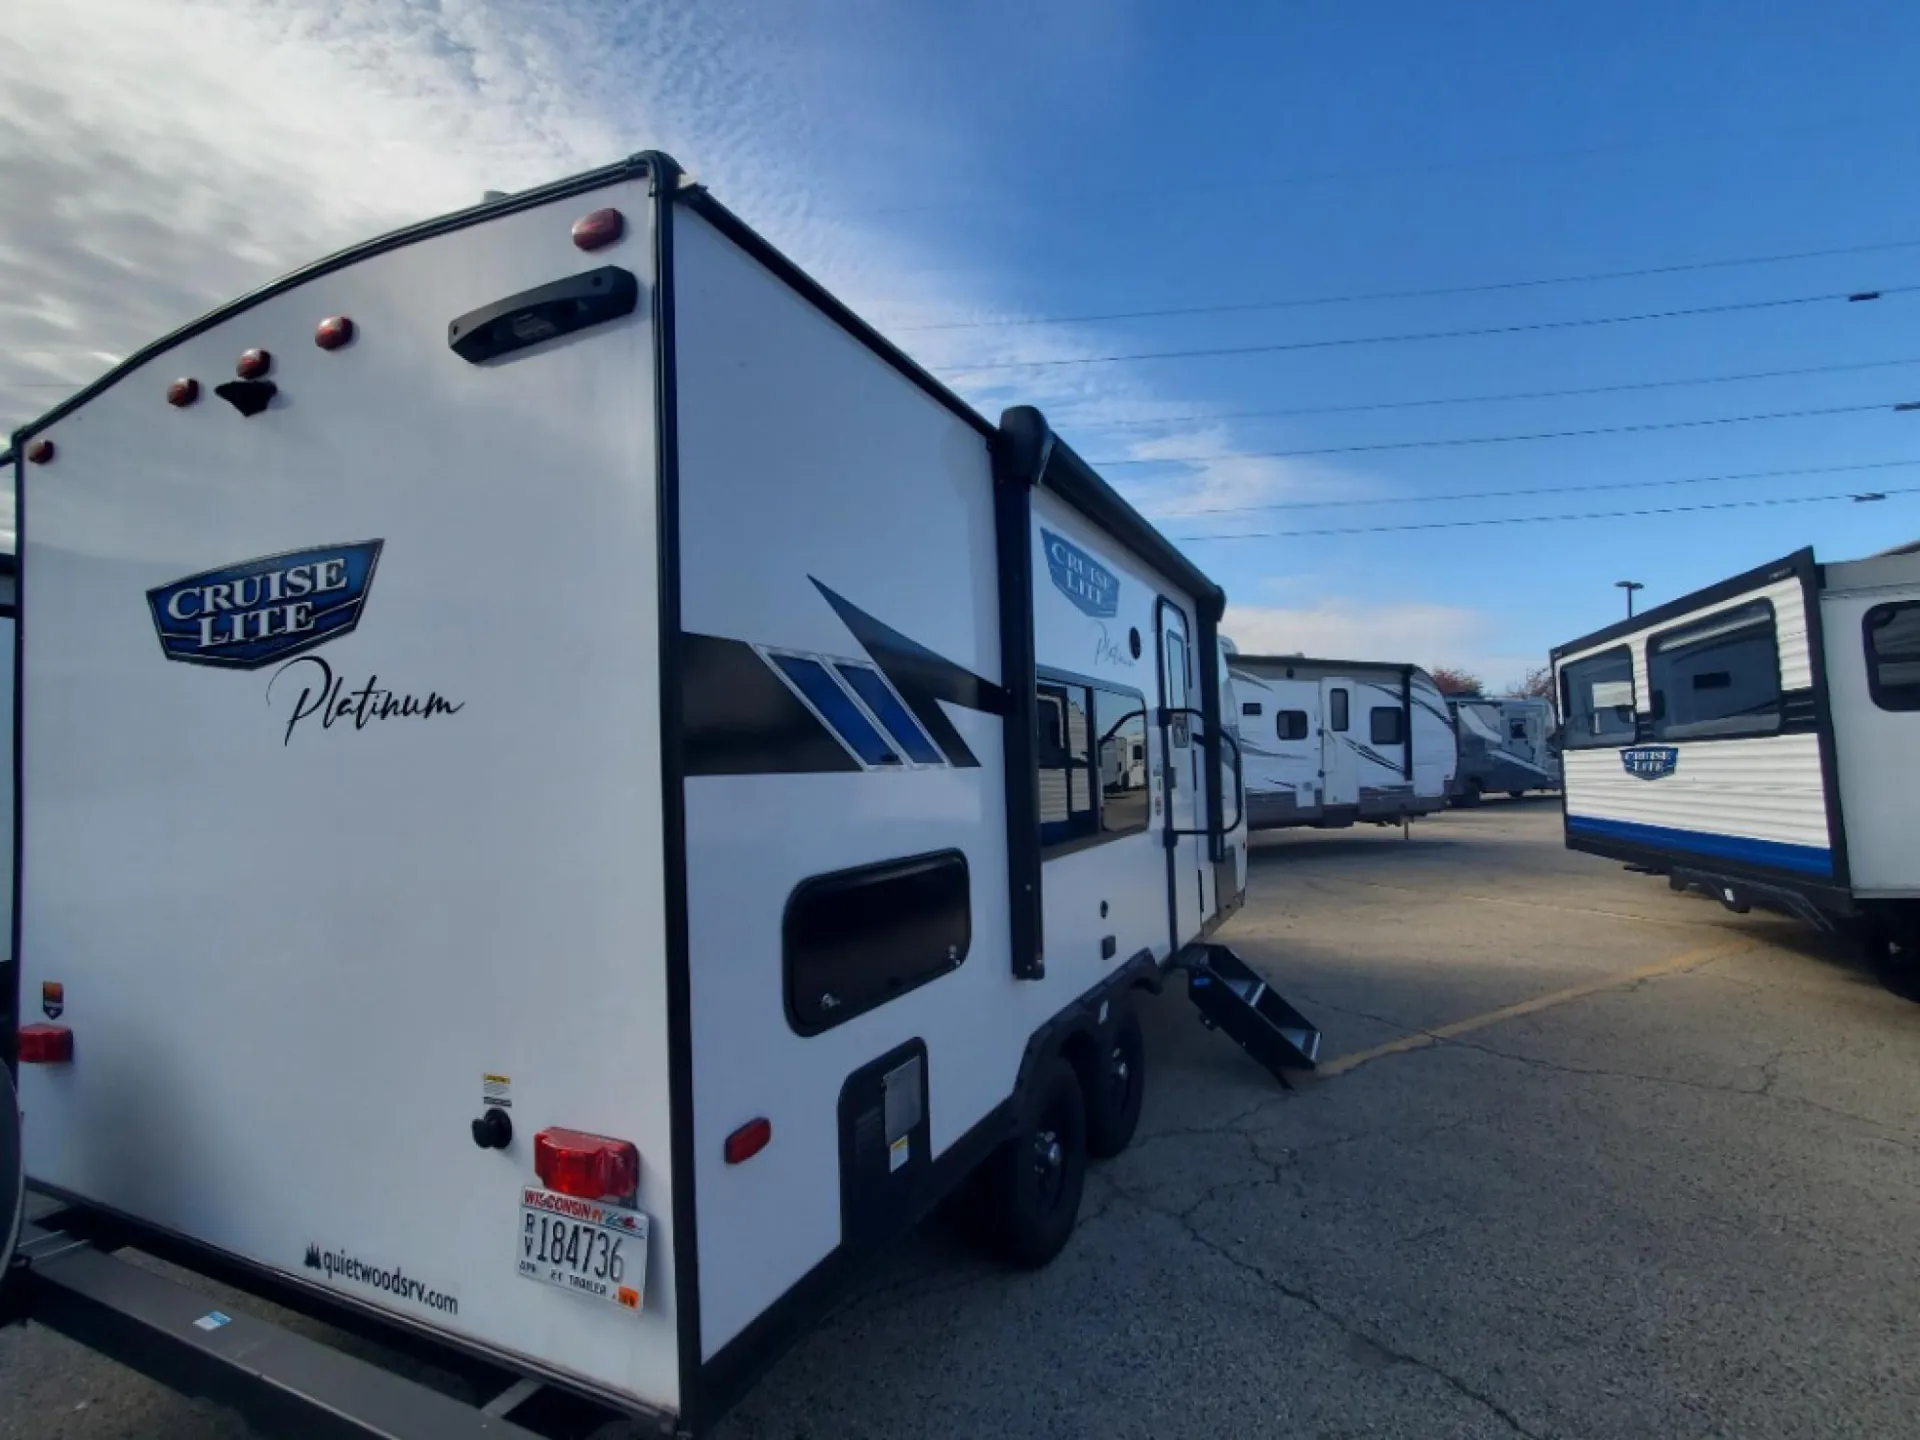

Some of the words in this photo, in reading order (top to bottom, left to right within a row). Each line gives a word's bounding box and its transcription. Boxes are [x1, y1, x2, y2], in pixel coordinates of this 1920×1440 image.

[168, 558, 347, 620] CRUISE
[197, 601, 316, 647] LITE
[265, 655, 465, 747] Platinum
[524, 1190, 592, 1220] WISCONSIN
[537, 1217, 624, 1282] 184736
[323, 1249, 458, 1315] quietwoodsrv.com
